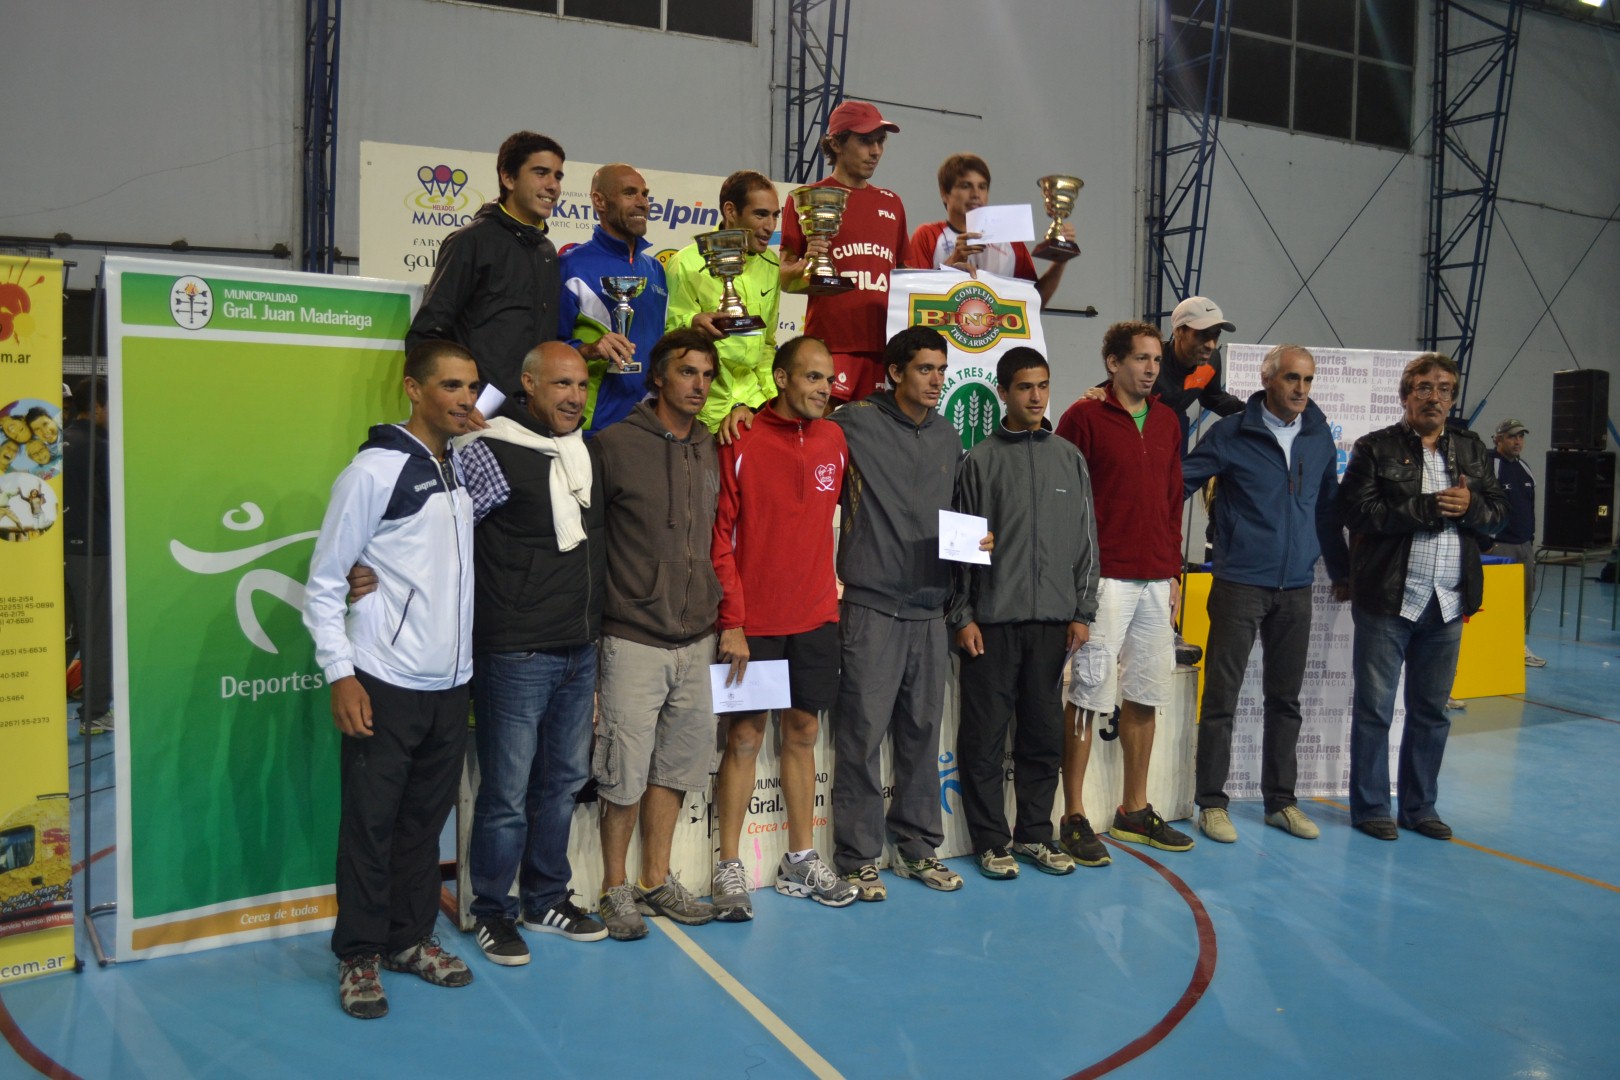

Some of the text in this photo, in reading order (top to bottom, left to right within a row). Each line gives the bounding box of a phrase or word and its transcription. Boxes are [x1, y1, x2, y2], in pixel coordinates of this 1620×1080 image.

[880, 190, 894, 198] FILA
[432, 204, 456, 212] HELADOS
[647, 197, 719, 230] elpin
[878, 209, 896, 220] FILA
[575, 222, 590, 230] LOS
[832, 242, 894, 264] CUMECHE
[403, 249, 436, 272] gal
[840, 270, 889, 293] FILA
[224, 288, 298, 304] MUNICIPALIDAD
[954, 287, 995, 305] COMPLEJO
[223, 301, 373, 331] Gral. Juan Madariaga
[917, 308, 1023, 330] BINGO
[950, 327, 1000, 347] TRES ARROYOS
[1230, 350, 1265, 363] Deport
[1315, 355, 1347, 366] portes
[956, 367, 984, 380] TRES
[1314, 366, 1368, 377] enos Aires
[1311, 392, 1345, 403] portes
[1371, 393, 1400, 405] Depor
[1370, 404, 1403, 415] Bueno
[1327, 413, 1366, 421] OVINCIA
[1314, 604, 1352, 612] OVINCIA
[1307, 660, 1327, 669] rtes
[1321, 669, 1347, 680] Aires
[221, 671, 324, 701] Deportes
[1296, 745, 1314, 754] nos
[748, 794, 784, 815] Gral.
[747, 821, 779, 834] Cerca
[240, 904, 319, 926] Cerca de todos
[1, 954, 66, 979] com.ar
